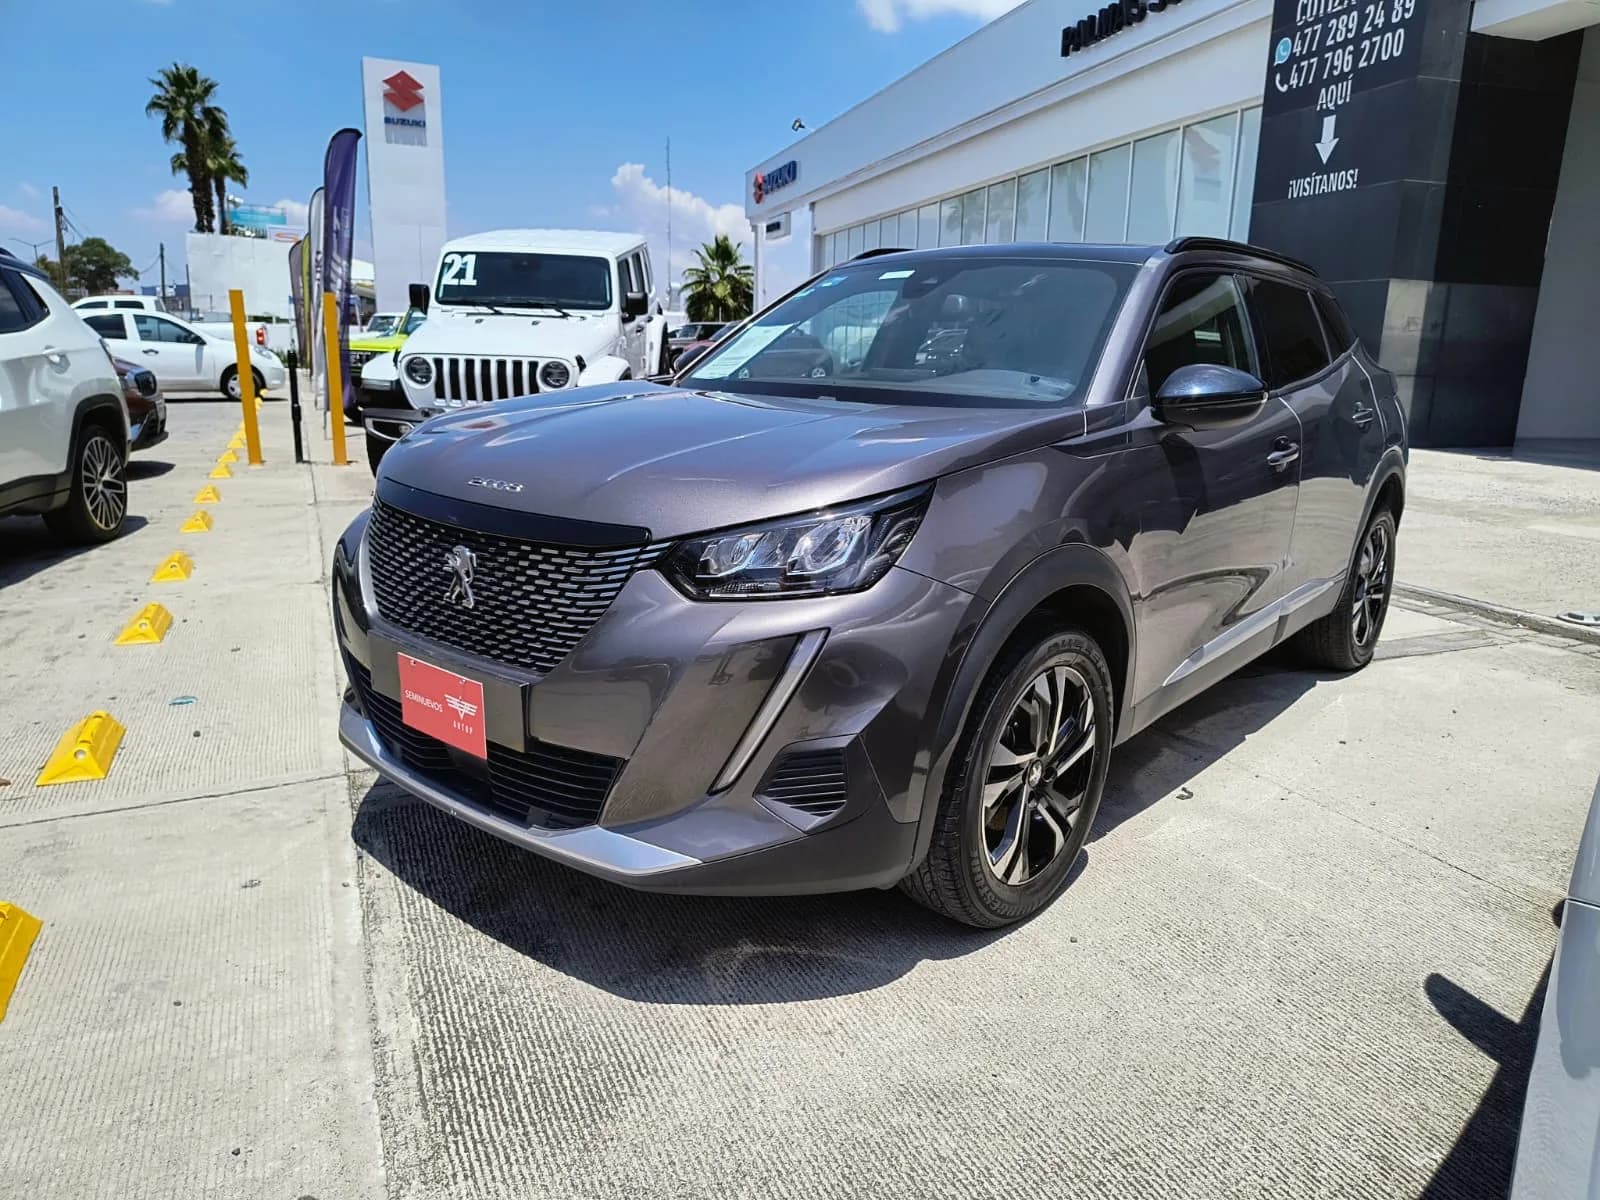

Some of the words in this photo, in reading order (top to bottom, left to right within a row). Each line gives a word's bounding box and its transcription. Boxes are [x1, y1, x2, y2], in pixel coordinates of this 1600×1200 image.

[1293, 24, 1322, 56] 477
[1326, 11, 1358, 46] 289
[1362, 4, 1386, 34] 24
[1391, 0, 1416, 23] 89
[1295, 0, 1357, 26] COT
[1289, 57, 1318, 88] 477
[1322, 45, 1354, 79] 796
[1358, 28, 1405, 68] 2700
[1316, 73, 1353, 111] AQUÍ
[384, 116, 426, 128] SUZUKI
[1288, 169, 1359, 199] ¡VISÍTANOS!
[442, 253, 477, 286] 21
[404, 689, 443, 712] SEMINUEVOS
